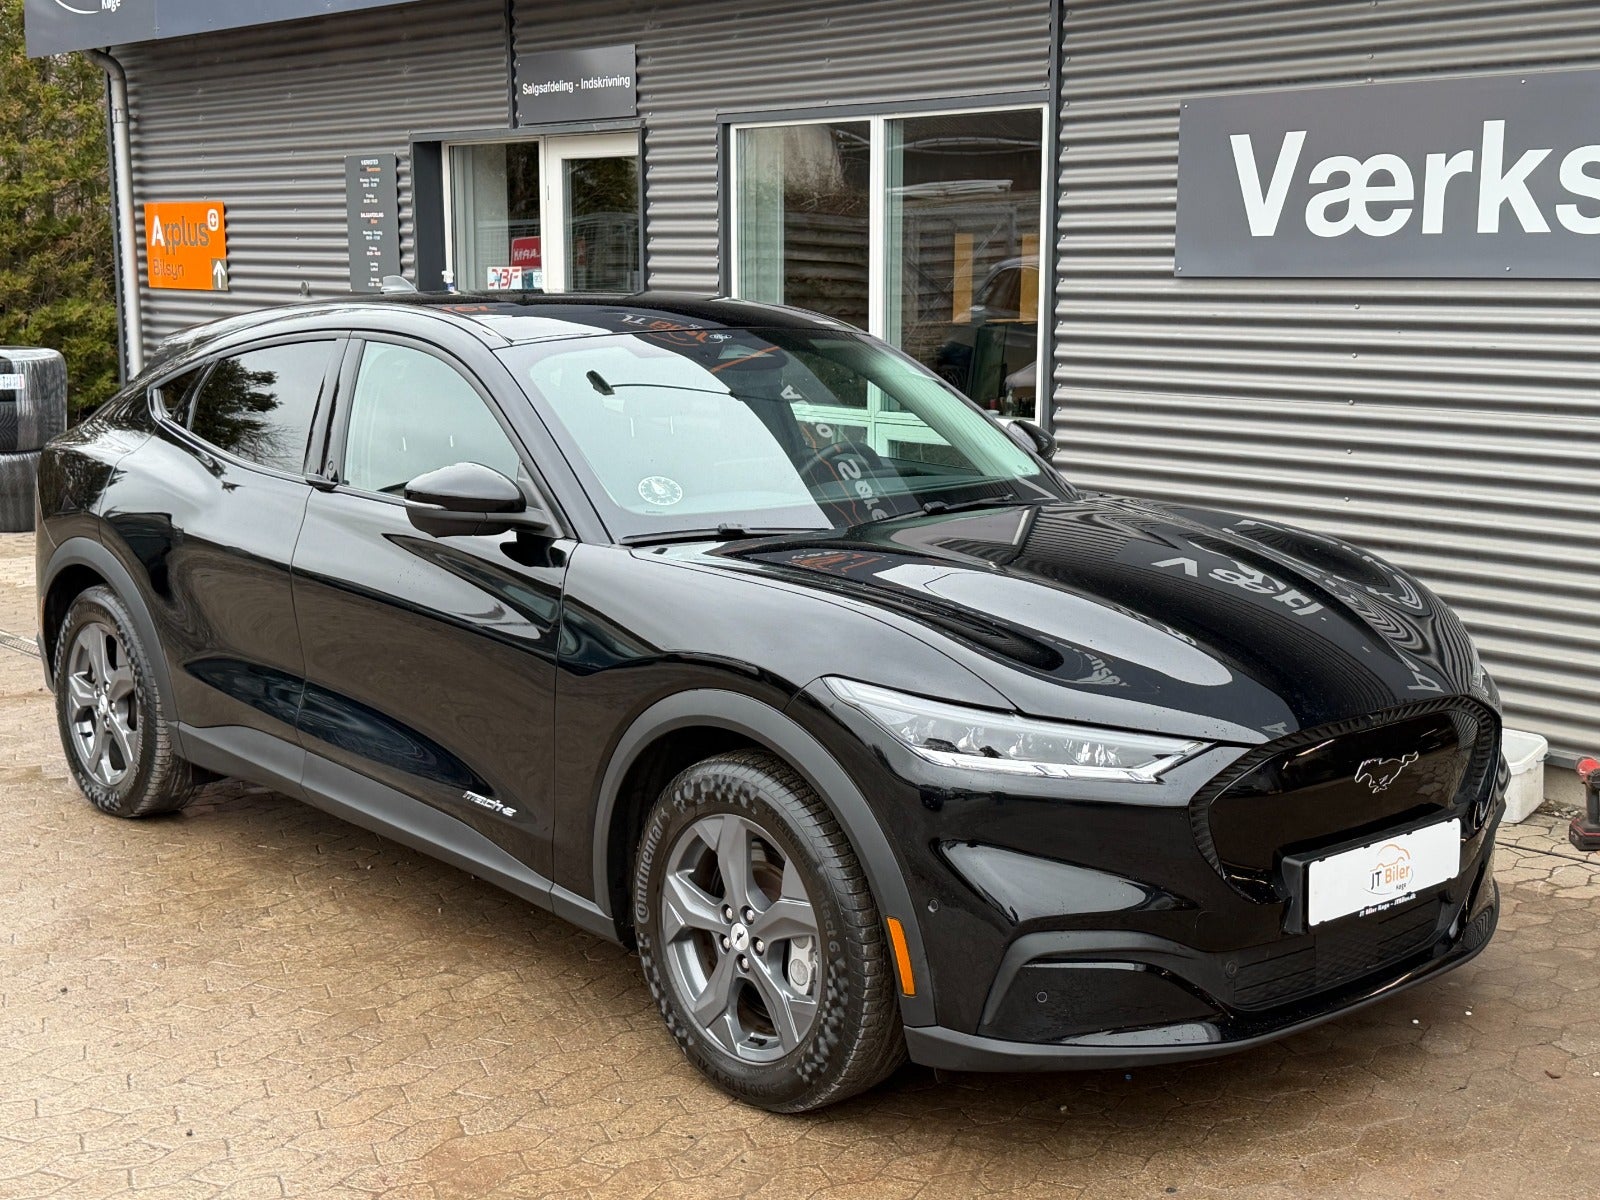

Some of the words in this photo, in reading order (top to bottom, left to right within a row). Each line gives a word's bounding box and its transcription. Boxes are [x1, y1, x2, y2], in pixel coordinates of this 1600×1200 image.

[522, 80, 574, 97] Salgsafdeling
[580, 74, 631, 89] Indskrivning
[152, 258, 185, 281] Bilsyn
[1371, 871, 1382, 890] JT
[1385, 865, 1410, 884] Biler
